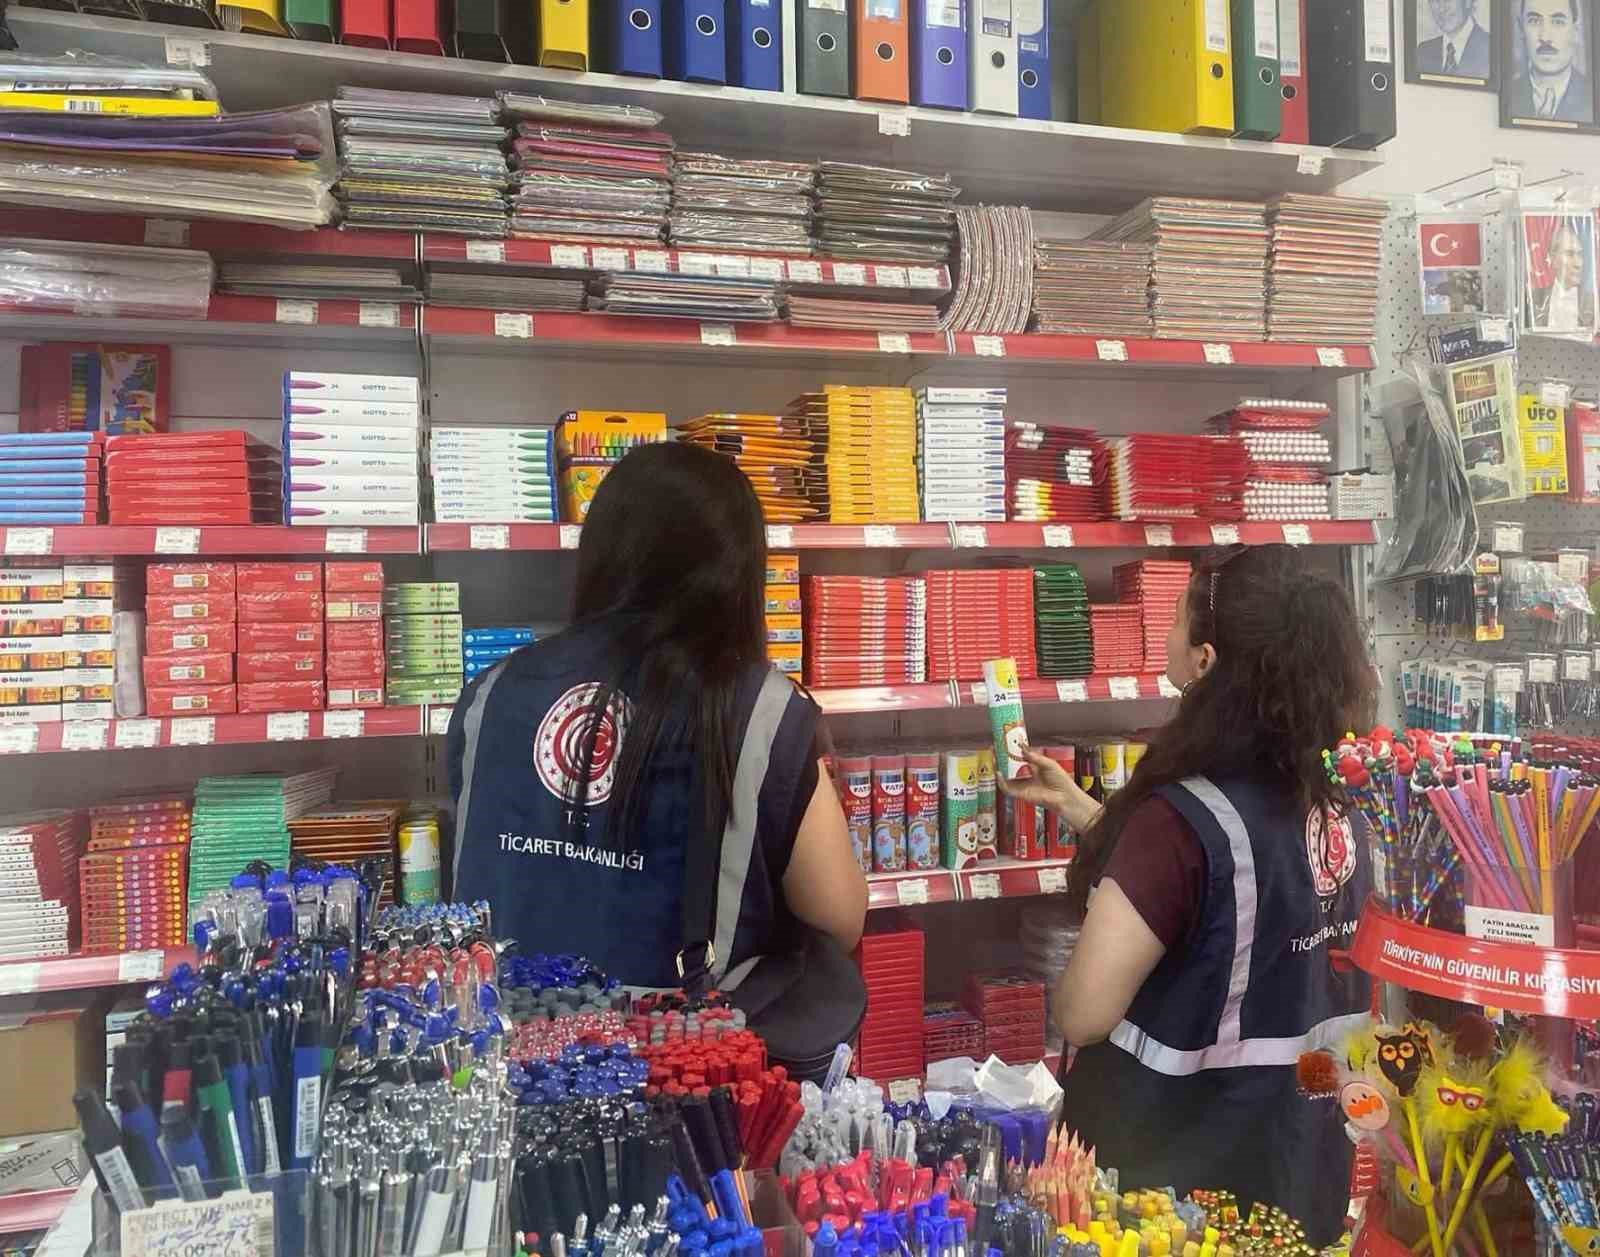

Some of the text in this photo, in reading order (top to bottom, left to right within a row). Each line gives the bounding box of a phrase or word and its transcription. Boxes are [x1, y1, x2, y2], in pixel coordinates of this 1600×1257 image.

[1527, 408, 1557, 421] UFO
[994, 693, 1007, 702] 24
[953, 787, 965, 797] 24
[498, 832, 644, 872] TİCARET BAKANLIĞI
[1383, 939, 1444, 971] TÜRKİYE'NİN
[1446, 959, 1520, 986] GÜVENİLİR
